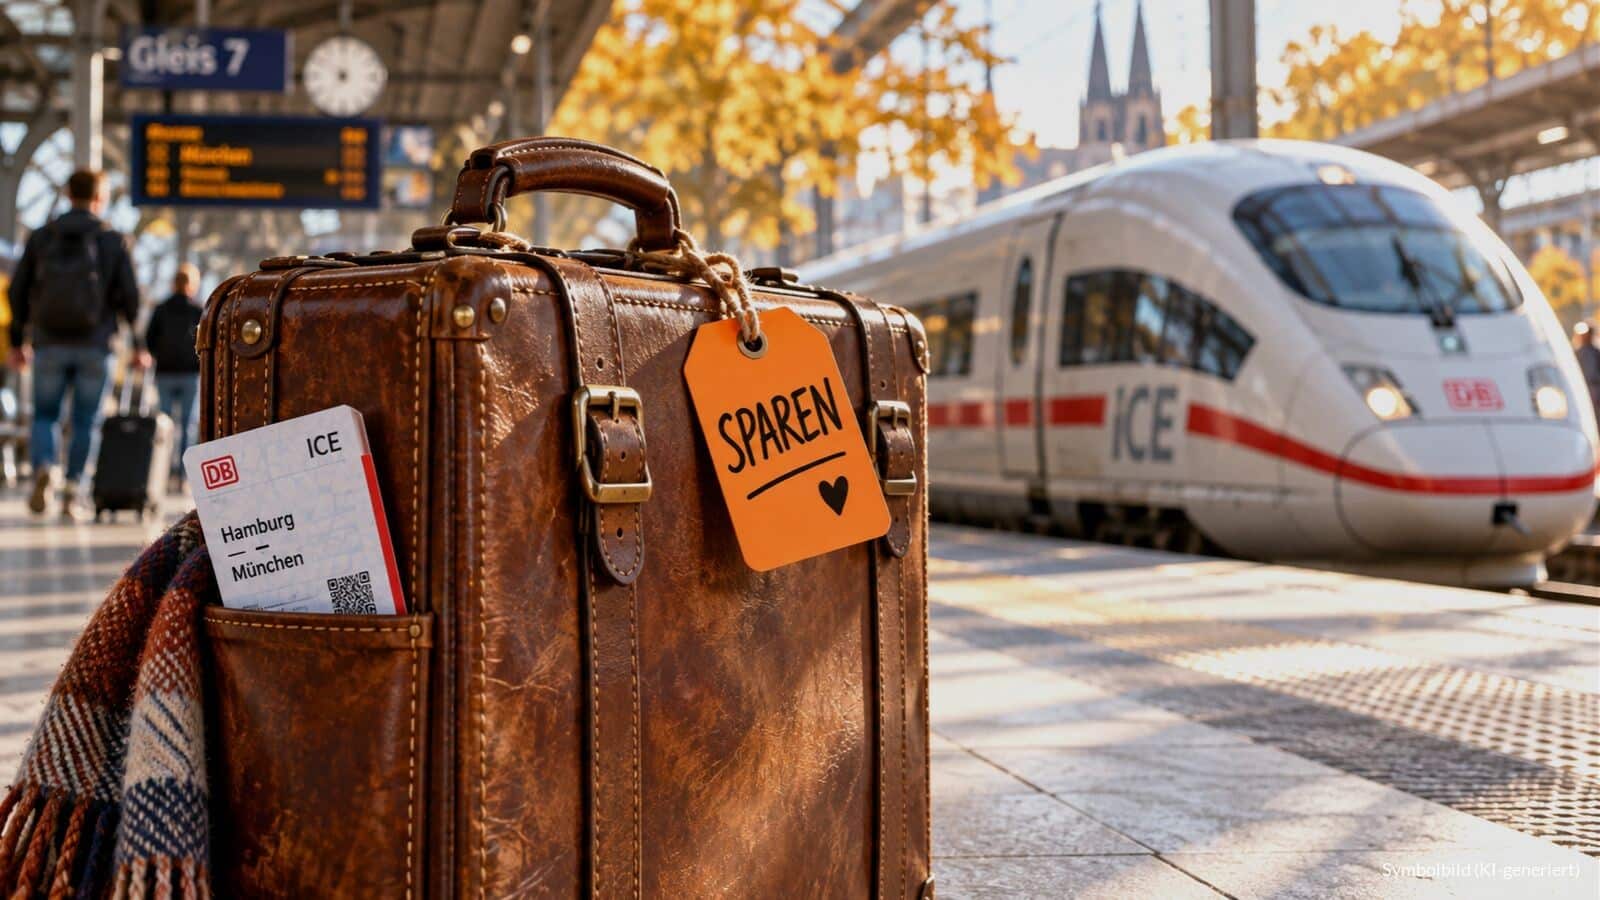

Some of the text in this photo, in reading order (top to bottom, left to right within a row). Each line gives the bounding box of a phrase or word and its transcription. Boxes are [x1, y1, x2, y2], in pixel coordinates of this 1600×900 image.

[129, 36, 250, 76] Gleis 7
[718, 377, 843, 473] SPAREN
[1111, 385, 1179, 462] ICE
[306, 431, 342, 458] ICE
[205, 460, 235, 485] DB
[220, 513, 295, 544] Hamburg
[231, 553, 305, 582] München
